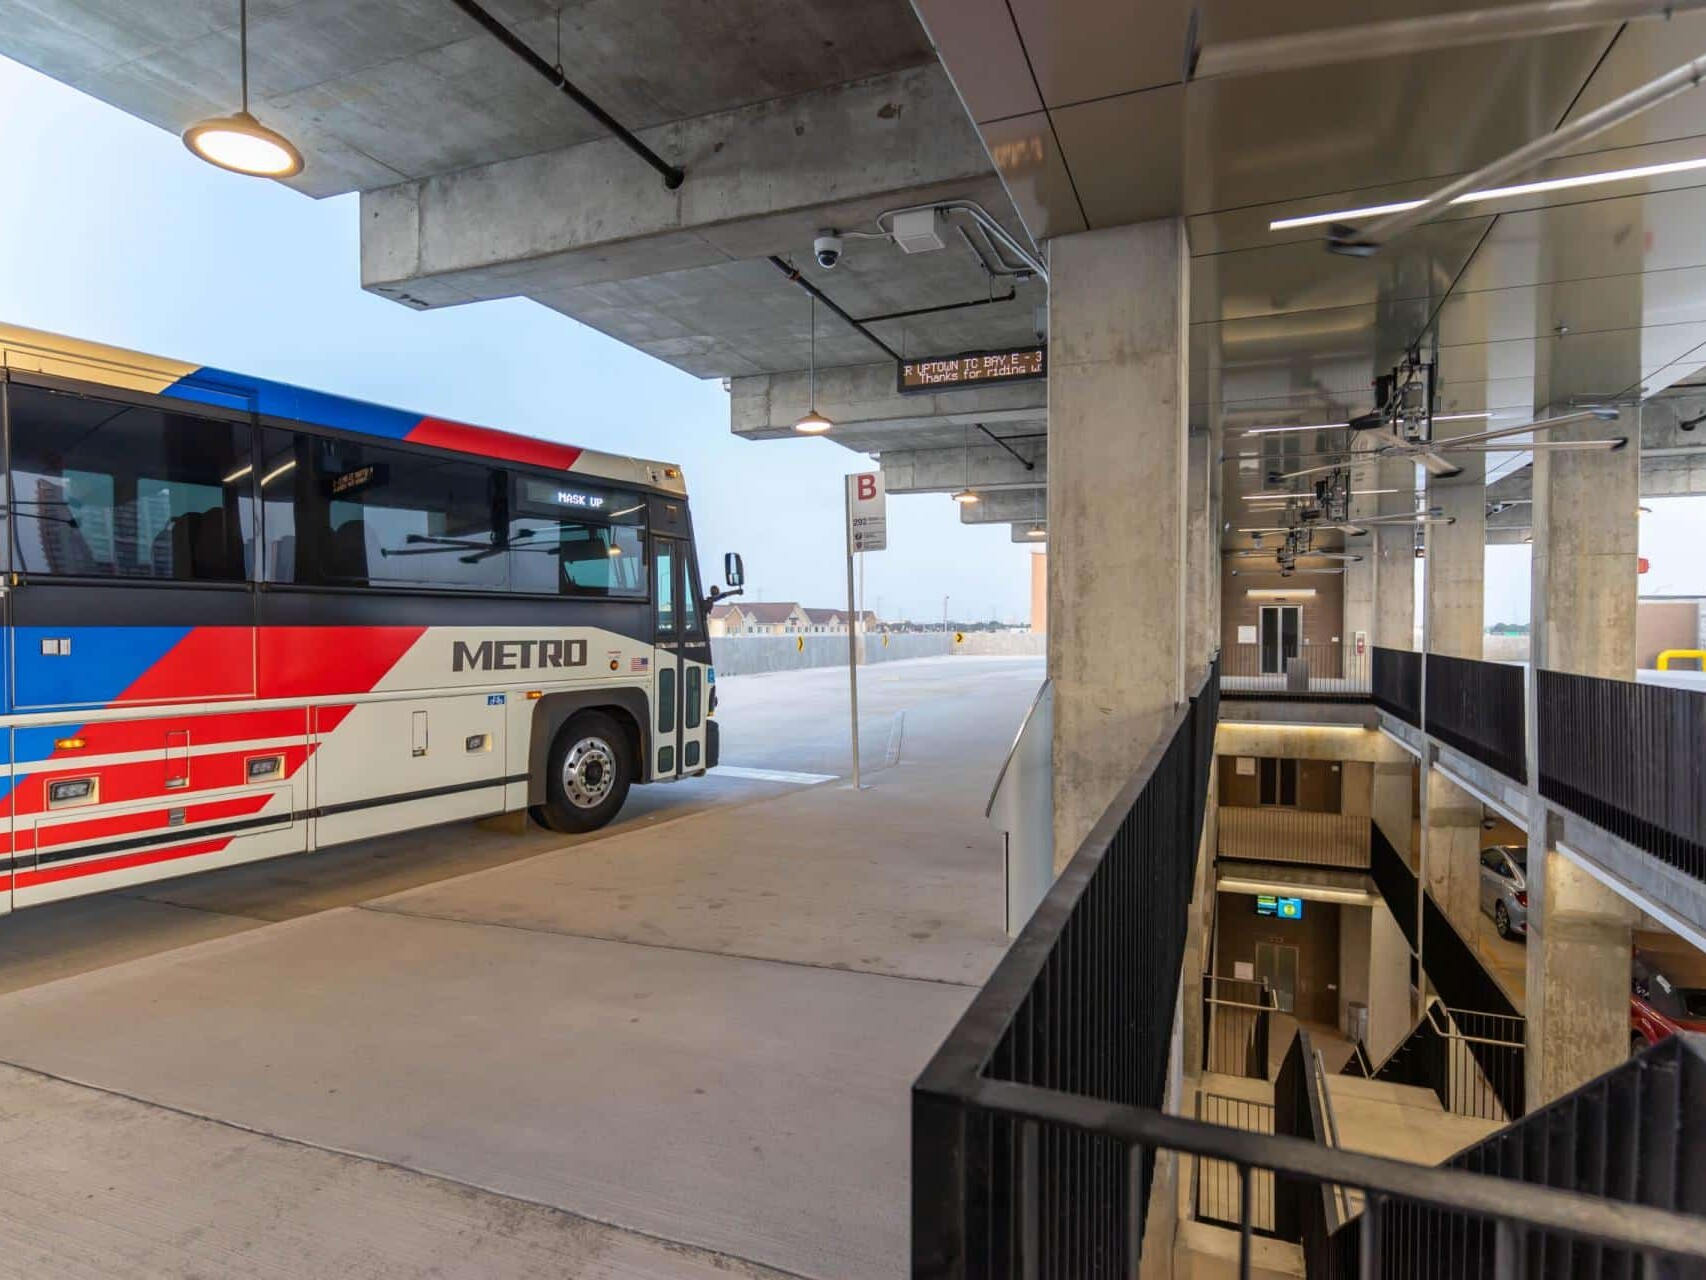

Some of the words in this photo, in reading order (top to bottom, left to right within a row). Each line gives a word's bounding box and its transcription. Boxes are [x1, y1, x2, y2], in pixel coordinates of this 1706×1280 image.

[917, 360, 959, 376] UPTOWN
[964, 358, 979, 369] TC
[984, 355, 1007, 368] BAY
[1011, 353, 1020, 364] E
[1035, 351, 1042, 362] 3
[921, 371, 959, 384] Thanks
[964, 369, 982, 379] for
[987, 364, 1026, 377] riding
[1031, 364, 1043, 373] w
[558, 491, 586, 506] MASK
[589, 496, 604, 508] UP
[857, 474, 877, 501] B
[452, 639, 588, 673] METRO
